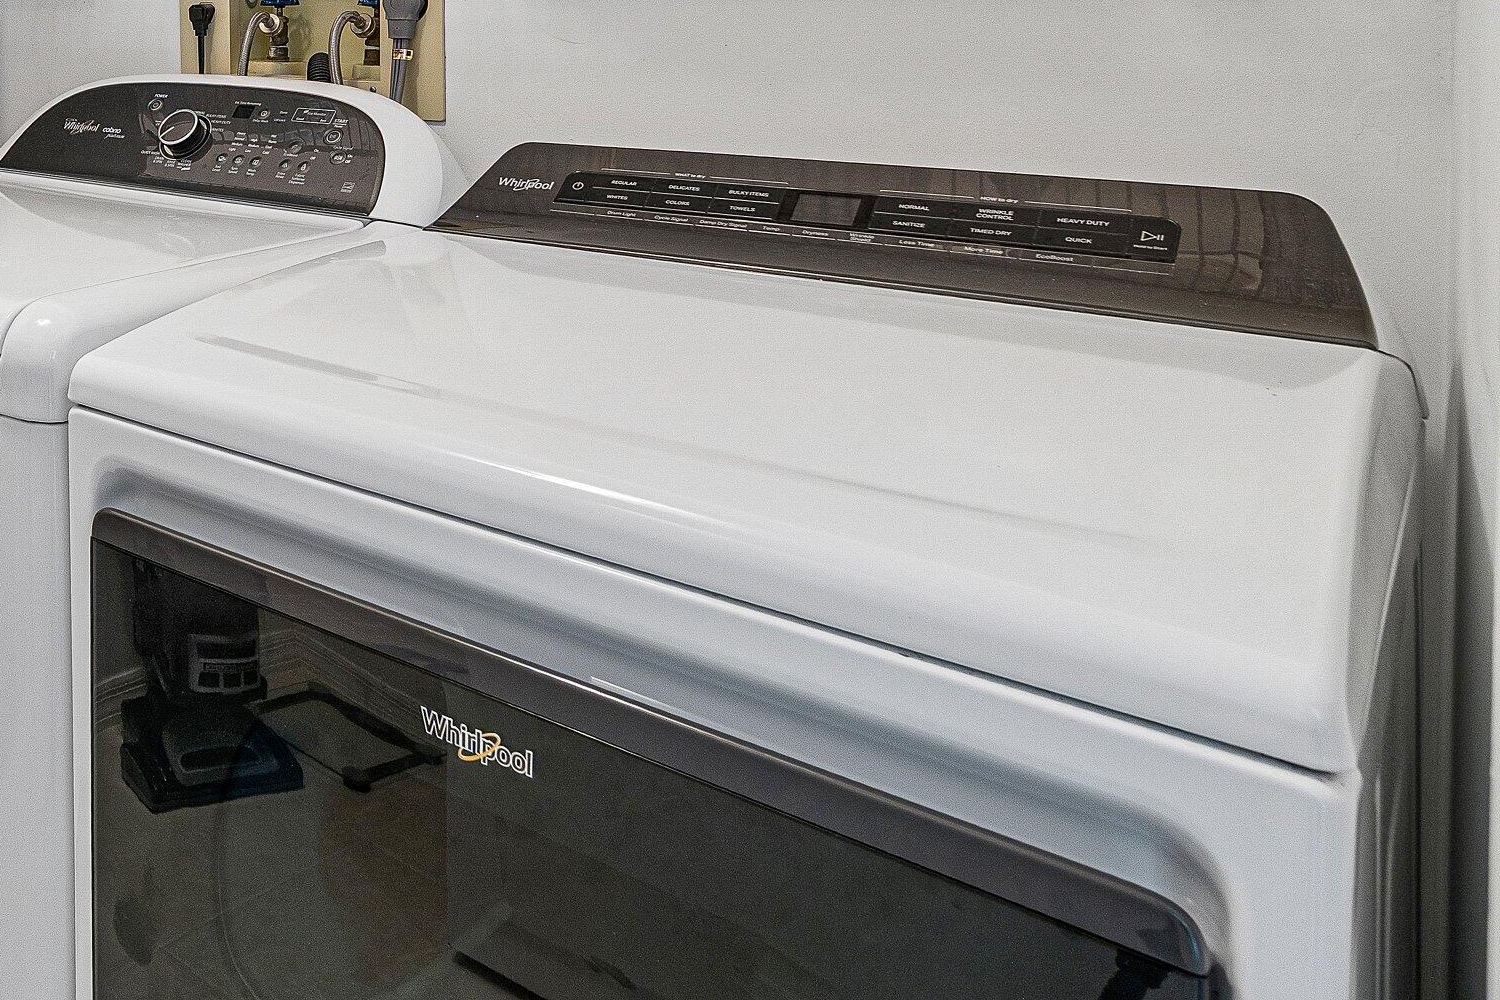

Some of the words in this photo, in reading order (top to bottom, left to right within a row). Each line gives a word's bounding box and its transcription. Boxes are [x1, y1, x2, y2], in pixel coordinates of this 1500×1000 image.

[63, 120, 100, 135] Whirlpool
[498, 176, 555, 191] Whirlpool
[668, 184, 700, 192] DELICATES
[898, 203, 930, 211] NORMAL
[978, 208, 1014, 216] WRINKLE
[975, 213, 1014, 221] CONTROL
[892, 220, 926, 228] SANITIZE
[1056, 217, 1086, 225] HEAVY
[1086, 219, 1110, 227] DUTY
[801, 229, 829, 237] Dryness
[970, 227, 994, 235] TIMED
[1065, 236, 1092, 244] QUICK
[964, 245, 983, 253] More
[1035, 253, 1074, 262] EcoBoost
[420, 705, 534, 779] Whirlpool
